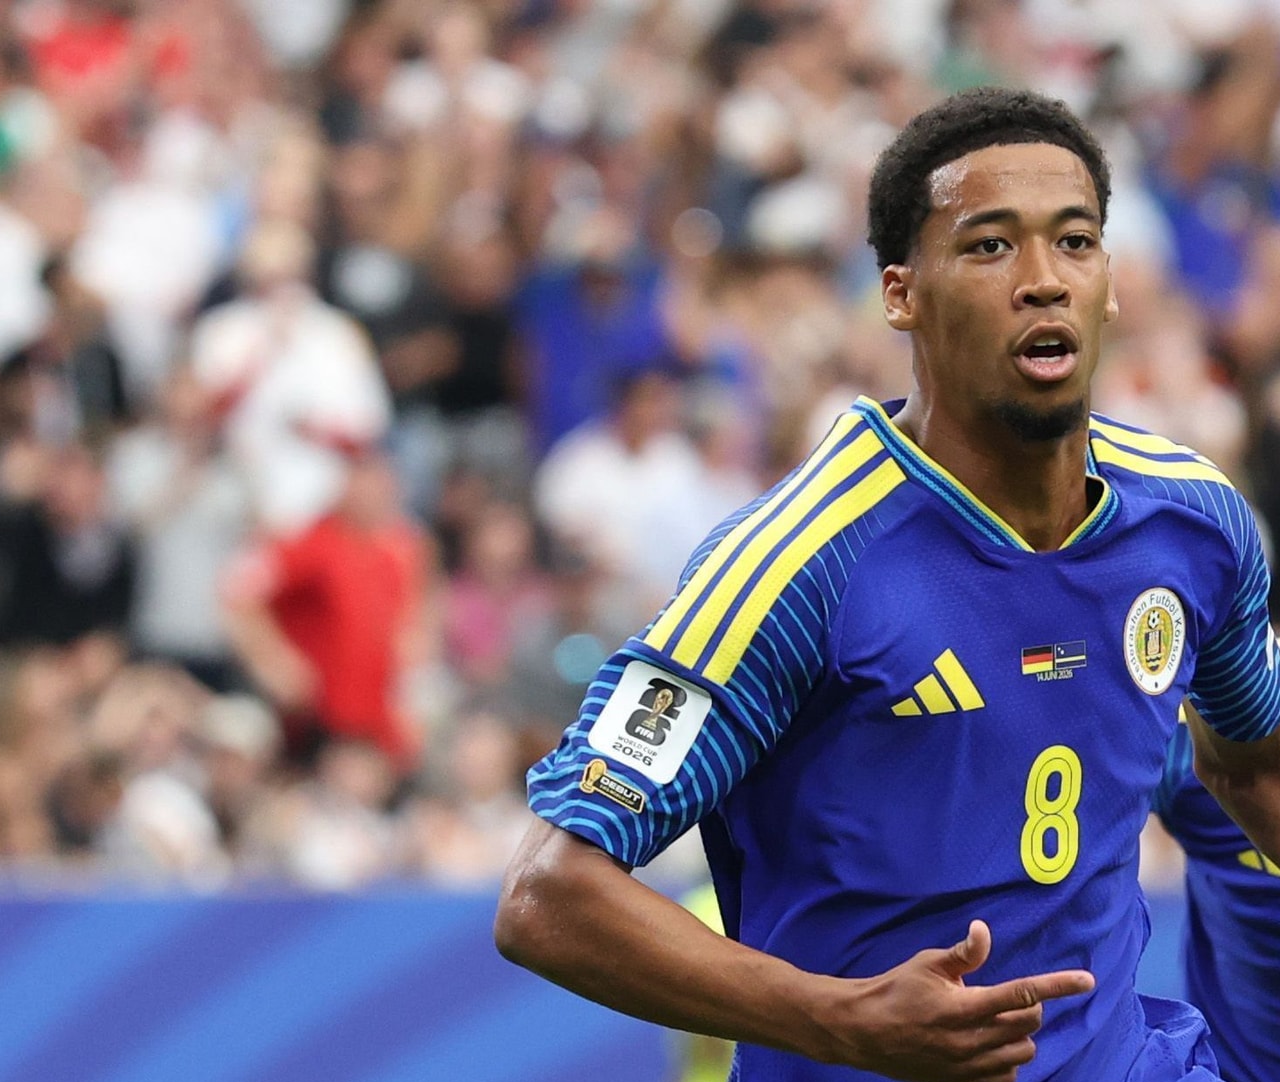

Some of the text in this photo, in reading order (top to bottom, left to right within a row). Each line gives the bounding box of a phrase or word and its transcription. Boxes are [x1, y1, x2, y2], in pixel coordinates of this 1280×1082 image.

[634, 726, 655, 740] FIFA
[612, 741, 653, 767] 2026
[617, 736, 658, 757] WORLD CUP
[600, 776, 641, 802] DEBUT
[1020, 745, 1082, 884] 8
